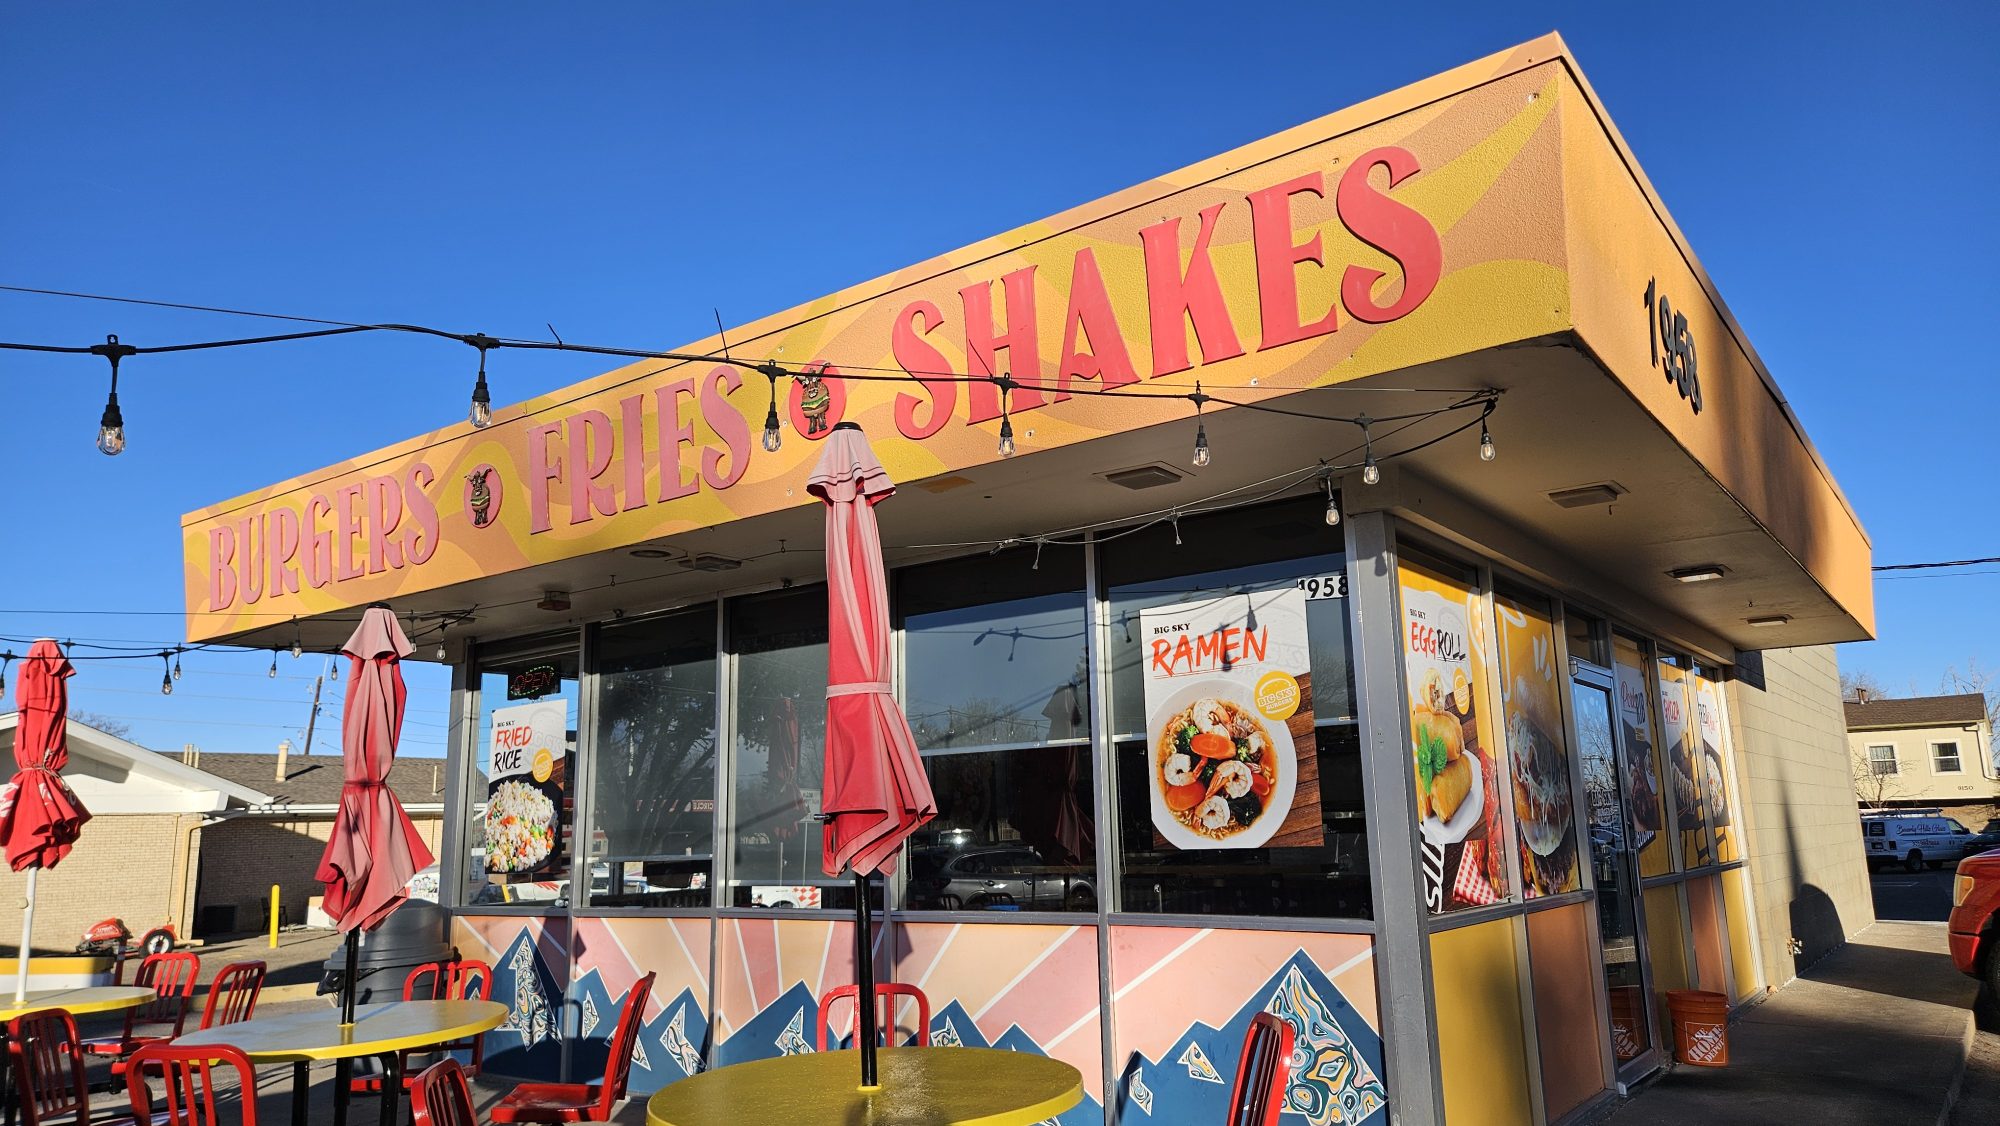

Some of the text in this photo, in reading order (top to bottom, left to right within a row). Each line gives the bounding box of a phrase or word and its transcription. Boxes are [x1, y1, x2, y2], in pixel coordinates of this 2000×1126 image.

[892, 145, 1443, 440] SHAKES
[1644, 275, 1702, 416] 1958
[526, 364, 751, 535] FRIES
[208, 462, 440, 612] BURGERS
[1154, 622, 1191, 634] BIG SKY
[1151, 624, 1269, 677] RAMEN
[513, 671, 551, 690] OPEN
[1258, 686, 1296, 707] BIG SKY
[495, 725, 533, 750] FRIED
[493, 749, 522, 773] RICE
[1689, 1024, 1723, 1061] HOME
[1691, 1027, 1708, 1042] THE
